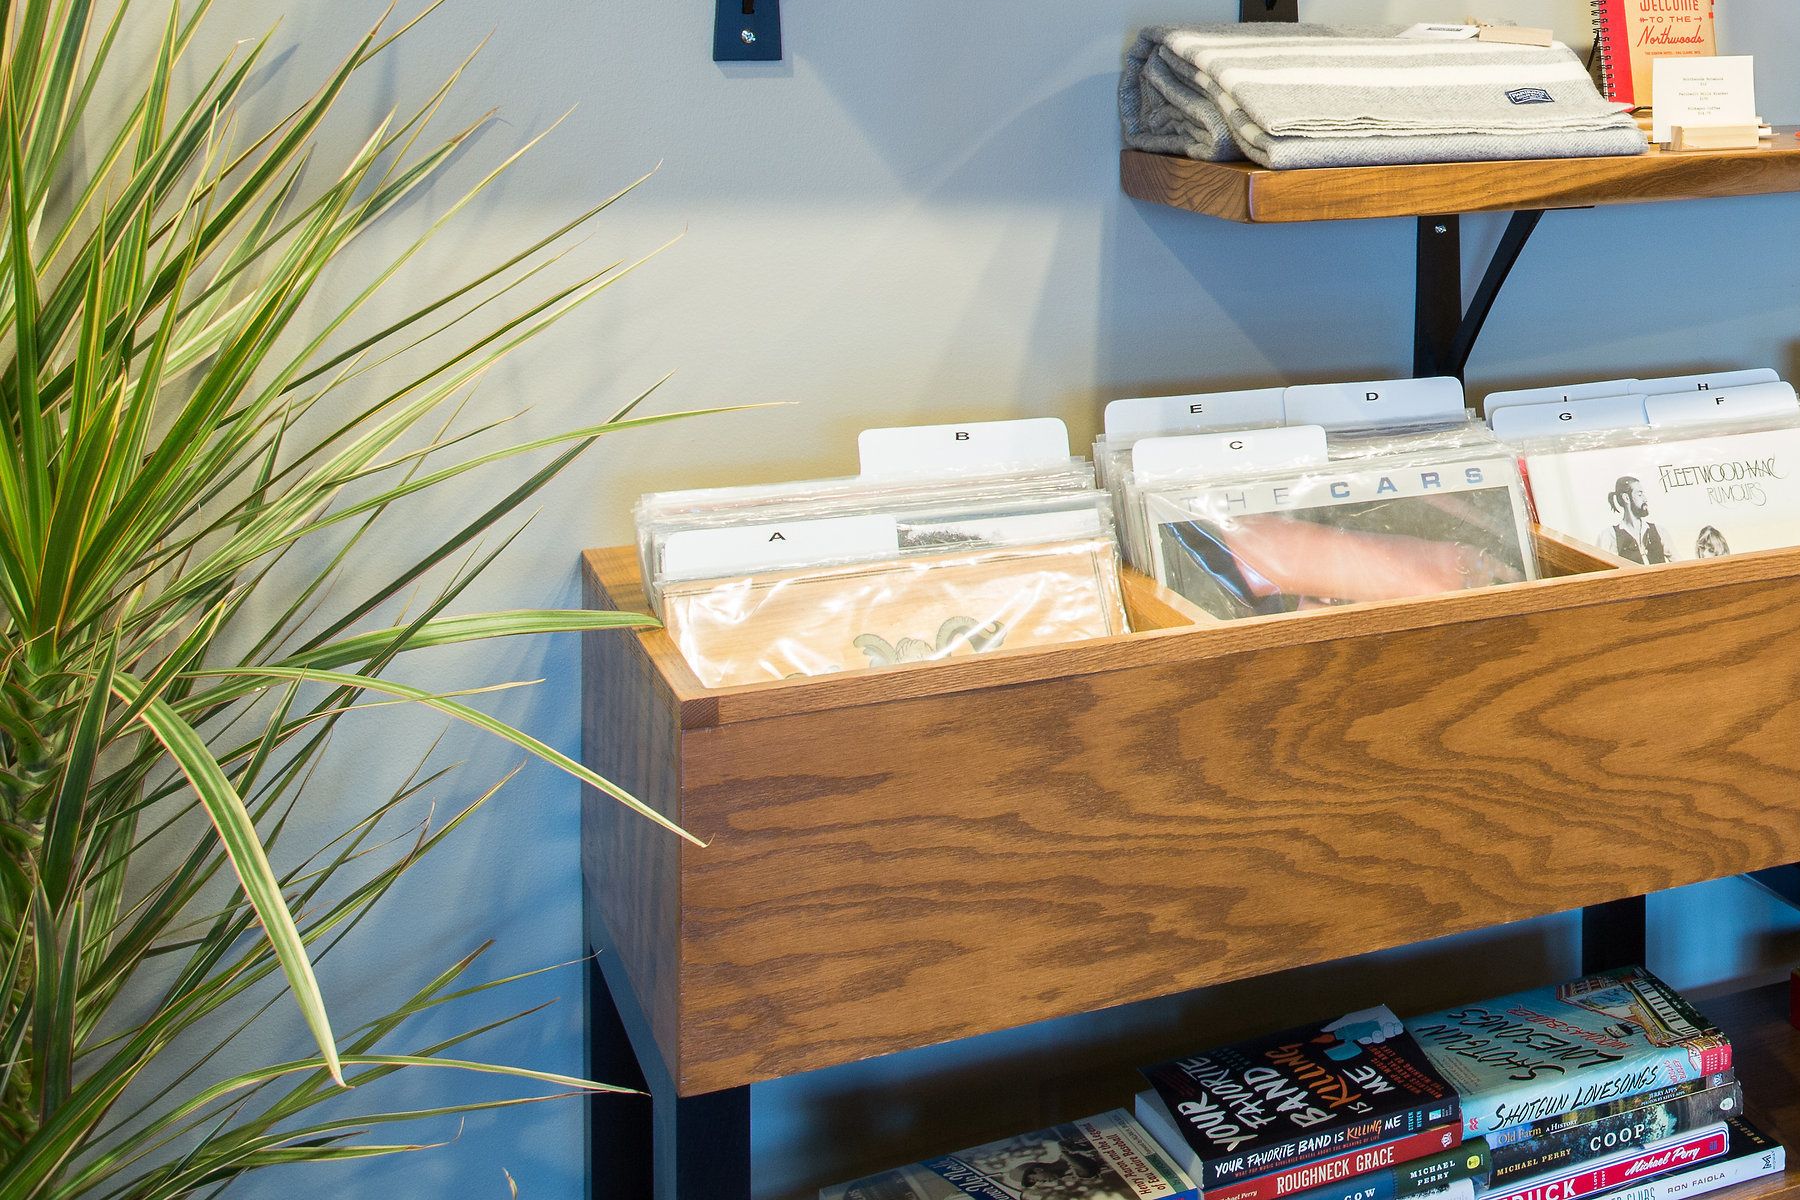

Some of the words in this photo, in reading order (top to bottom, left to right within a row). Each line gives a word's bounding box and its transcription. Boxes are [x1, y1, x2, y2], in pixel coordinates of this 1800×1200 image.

[1669, 15, 1692, 23] THE
[1636, 24, 1705, 48] Northwoods
[1366, 391, 1379, 402] D
[1697, 382, 1709, 391] H
[1189, 404, 1203, 415] E
[1715, 396, 1725, 406] F
[1558, 412, 1573, 422] G
[955, 431, 970, 442] B
[1229, 440, 1244, 451] C
[1658, 460, 1744, 493] FLEETWOOD
[1745, 453, 1790, 481] MAC
[1179, 487, 1292, 513] THE
[1330, 467, 1484, 499] CARS
[1706, 482, 1768, 507] RUMOURS
[768, 531, 787, 543] A
[1446, 1007, 1625, 1069] LOVESONGS
[1416, 1023, 1566, 1082] SHOTGUN
[1265, 1044, 1361, 1109] KILLING
[1343, 1064, 1396, 1095] ME
[1176, 1054, 1277, 1130] FAVORITE
[1243, 1066, 1338, 1128] BAND
[1488, 1094, 1569, 1131] SHOTGUN
[1570, 1065, 1659, 1109] LOVESONGS
[1177, 1091, 1258, 1152] YOUR
[1497, 1130, 1517, 1144] Old
[1518, 1127, 1542, 1141] Farm
[1551, 1119, 1578, 1132] HISTORY
[1215, 1157, 1244, 1178] YOUR
[1247, 1144, 1295, 1168] FAVORITE
[1298, 1134, 1331, 1153] BAND
[1334, 1131, 1345, 1143] IS
[1346, 1119, 1382, 1142] KILLING
[1384, 1115, 1402, 1130] ME
[1496, 1159, 1539, 1177] MICHAEL
[1541, 1148, 1572, 1163] PERRY
[1589, 1123, 1645, 1152] COOP
[1276, 1158, 1350, 1195] ROUGHNECK
[1355, 1146, 1395, 1173] GRACE
[1409, 1160, 1456, 1179] MICHAEL
[1624, 1150, 1670, 1177] Michael
[1670, 1145, 1701, 1164] Perry
[1417, 1171, 1450, 1187] PERRY
[1667, 1181, 1690, 1194] RON
[1691, 1171, 1726, 1188] FAIOLA
